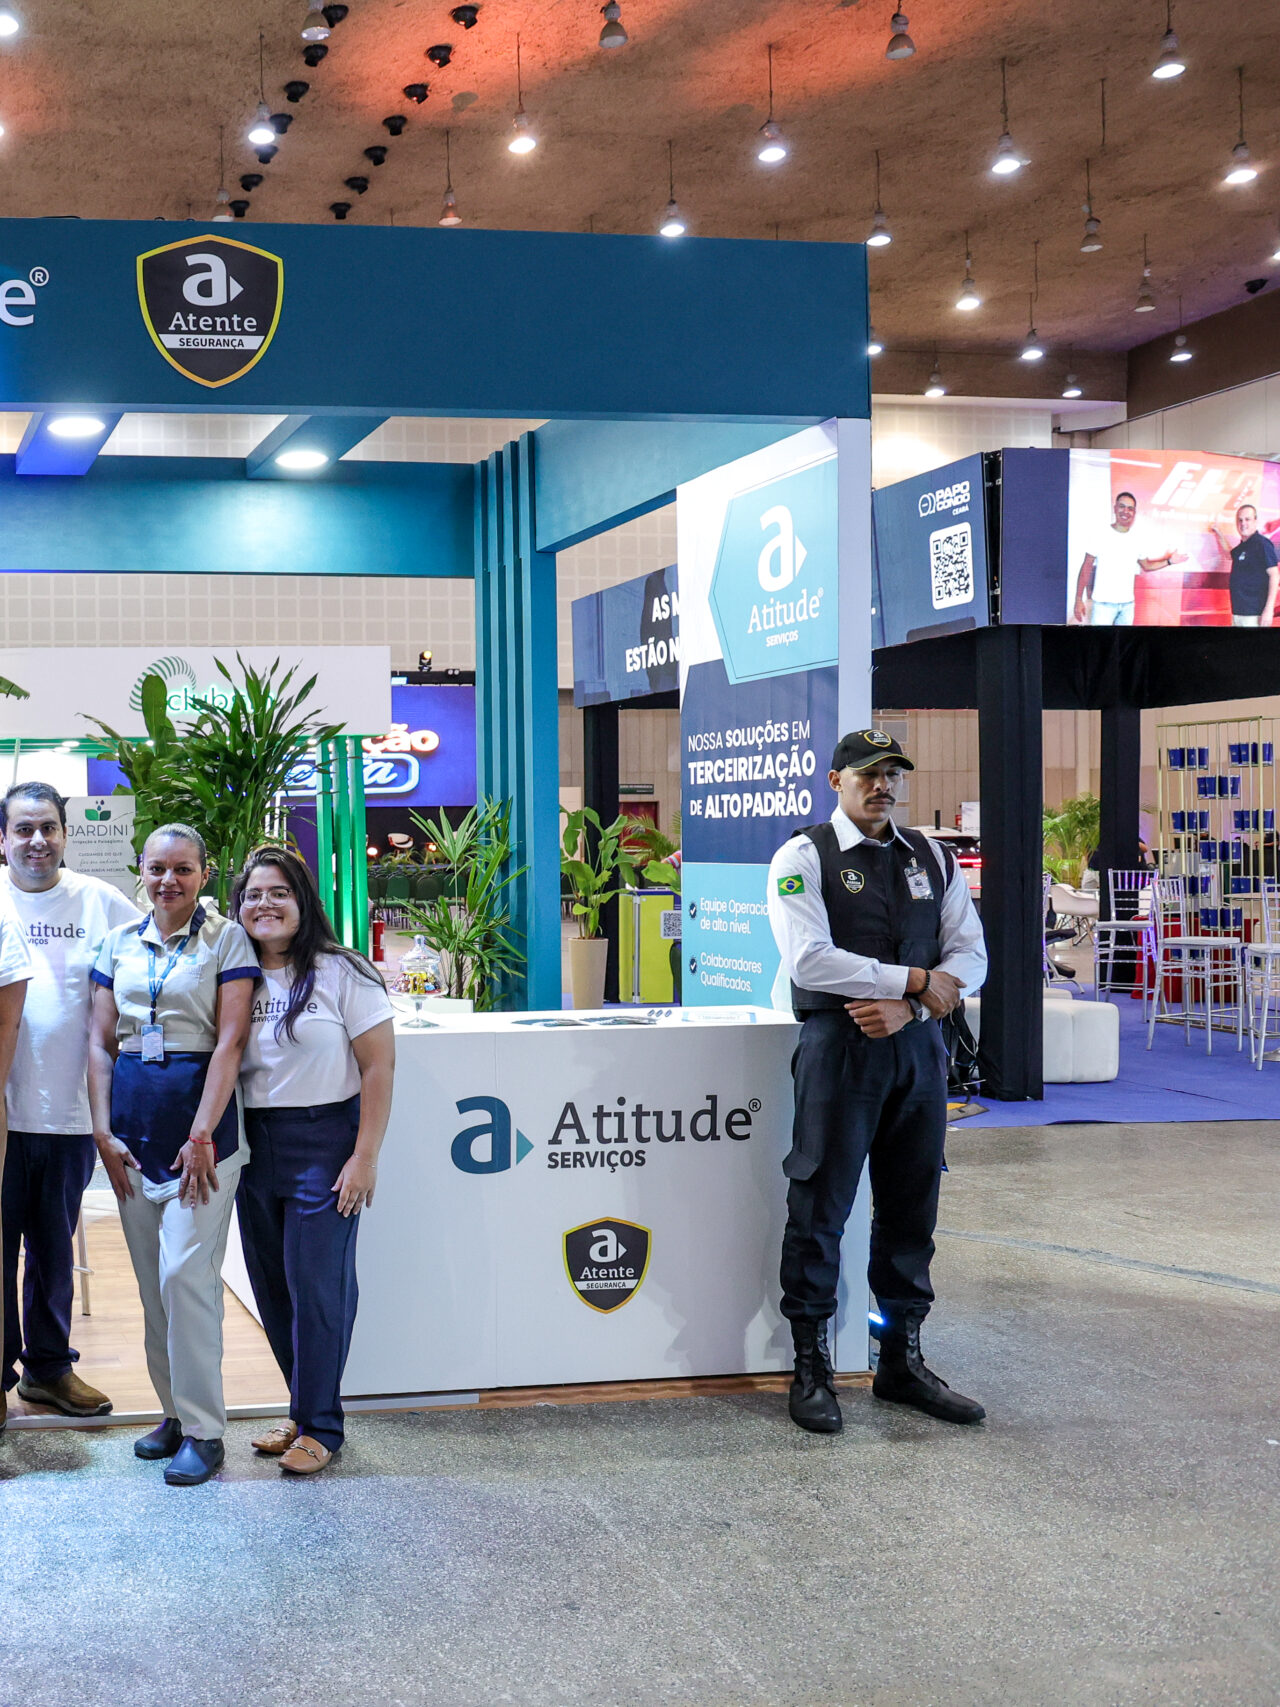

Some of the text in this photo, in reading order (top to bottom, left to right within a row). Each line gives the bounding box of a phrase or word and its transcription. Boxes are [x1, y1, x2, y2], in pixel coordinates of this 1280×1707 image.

[168, 311, 258, 333] Atente
[178, 337, 245, 350] SEGURANÇA
[935, 480, 970, 501] PAPO
[936, 492, 971, 511] CONDO
[651, 596, 671, 623] AS
[765, 629, 800, 648] SERVIÇOS
[624, 635, 668, 674] ESTÃO
[687, 719, 811, 752] NOSSA SOLUÇÕES EM
[687, 744, 817, 788] TERCEIRIZAÇÃO
[689, 782, 813, 819] DE ALTO PADRÃO
[67, 824, 128, 837] JARDINI
[700, 897, 769, 917] Equipe Operacio
[25, 921, 86, 938] titude
[700, 916, 711, 930] de
[712, 918, 728, 932] alto
[27, 938, 49, 946] VIÇOS
[700, 952, 763, 974] Colaboradores
[700, 971, 753, 992] Qualificados.
[251, 997, 318, 1015] Atitue
[547, 1149, 647, 1173] SERVIÇOS
[580, 1265, 635, 1280] Atente
[586, 1281, 626, 1290] SEGURANÇA
